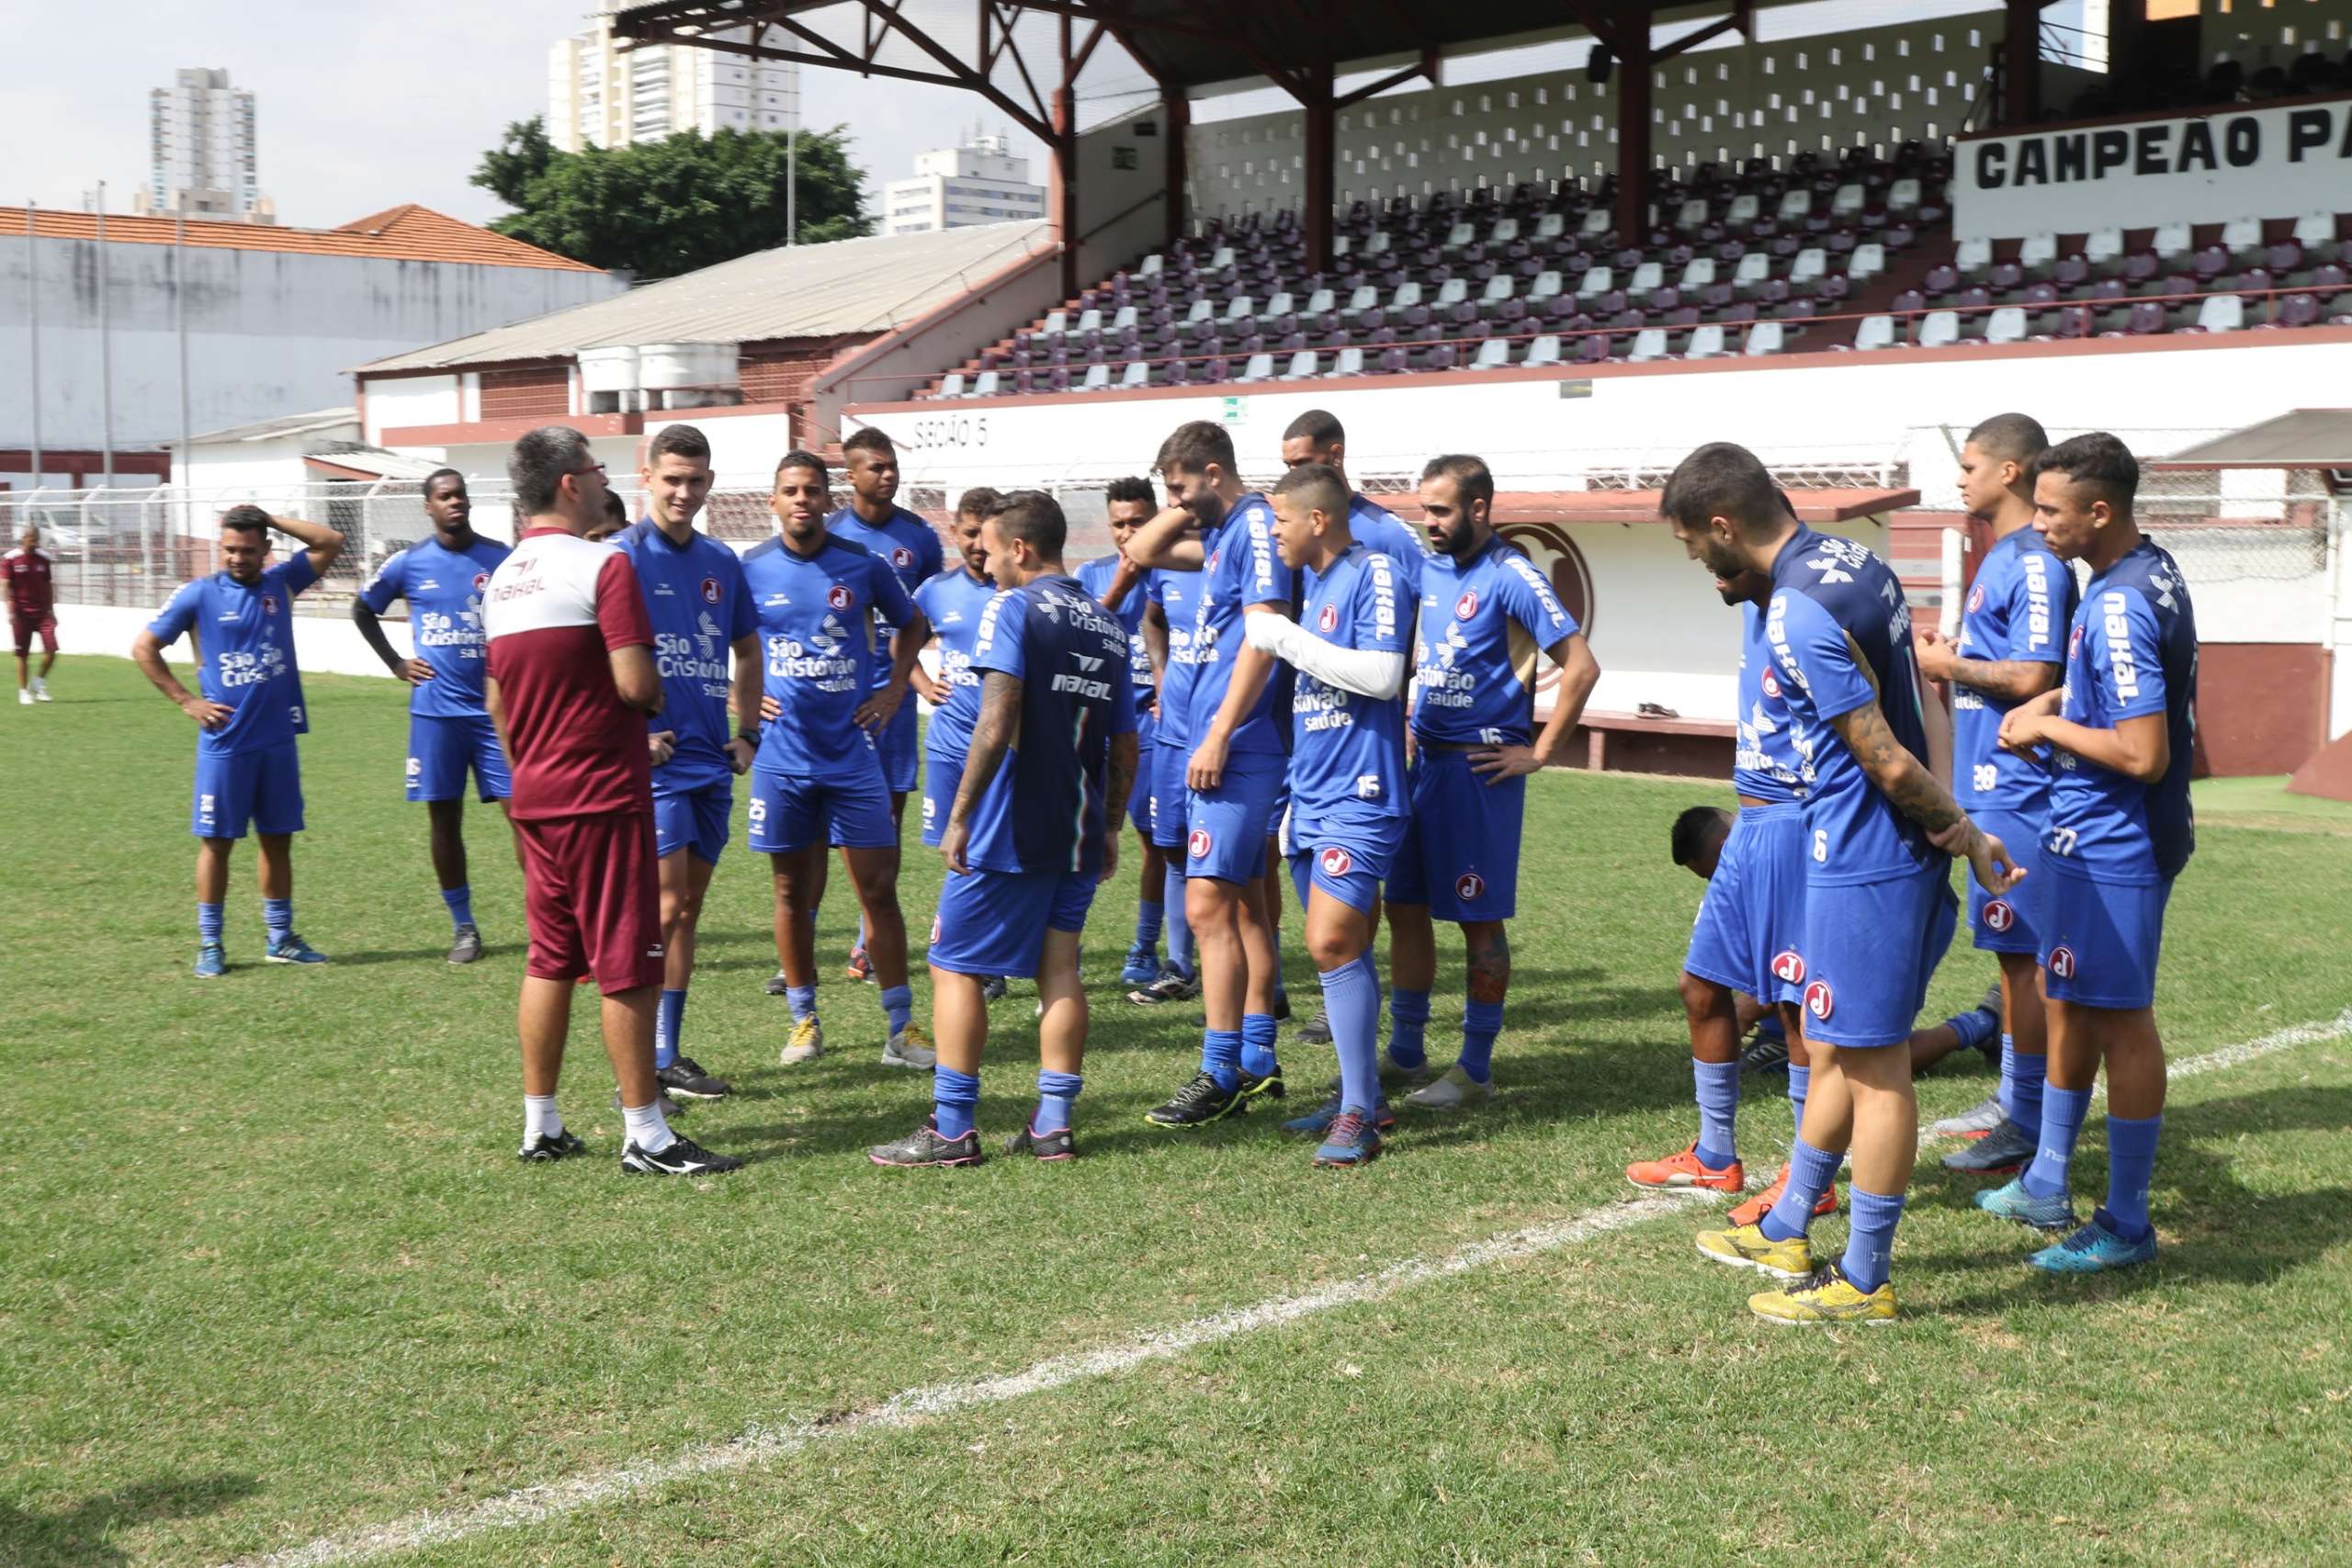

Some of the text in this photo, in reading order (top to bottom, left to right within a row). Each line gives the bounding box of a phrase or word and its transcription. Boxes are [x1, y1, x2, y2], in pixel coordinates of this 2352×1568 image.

[977, 417, 987, 446] 5
[654, 633, 691, 655] São
[768, 637, 803, 658] São
[1427, 689, 1474, 707] saúde
[1357, 774, 1380, 798] 15
[1814, 829, 1828, 863] 6
